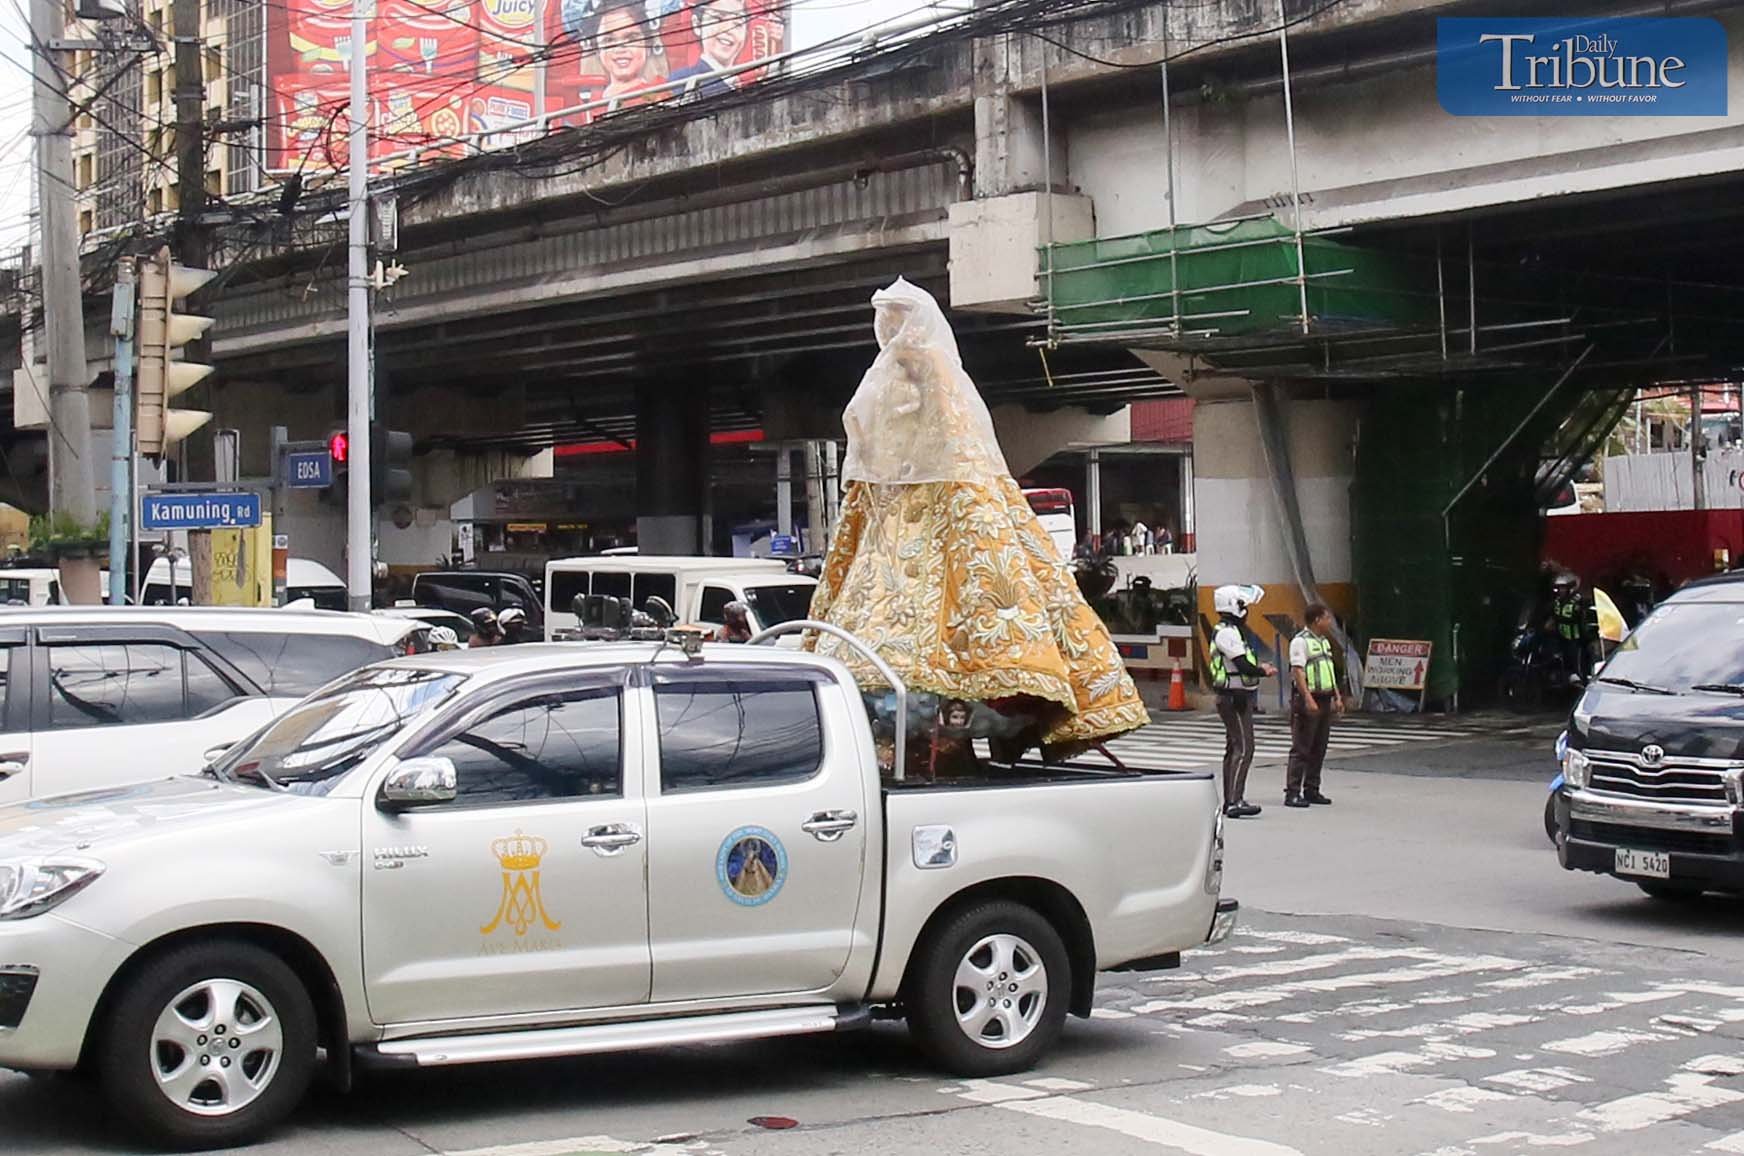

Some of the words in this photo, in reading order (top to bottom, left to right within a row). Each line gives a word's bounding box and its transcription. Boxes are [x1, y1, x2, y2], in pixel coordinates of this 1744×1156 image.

[492, 0, 535, 15] Juicy
[297, 461, 321, 479] EDSA
[236, 505, 251, 518] Rd
[1377, 643, 1422, 655] DANGER
[1380, 657, 1402, 666] MEN
[1642, 856, 1667, 872] 5420
